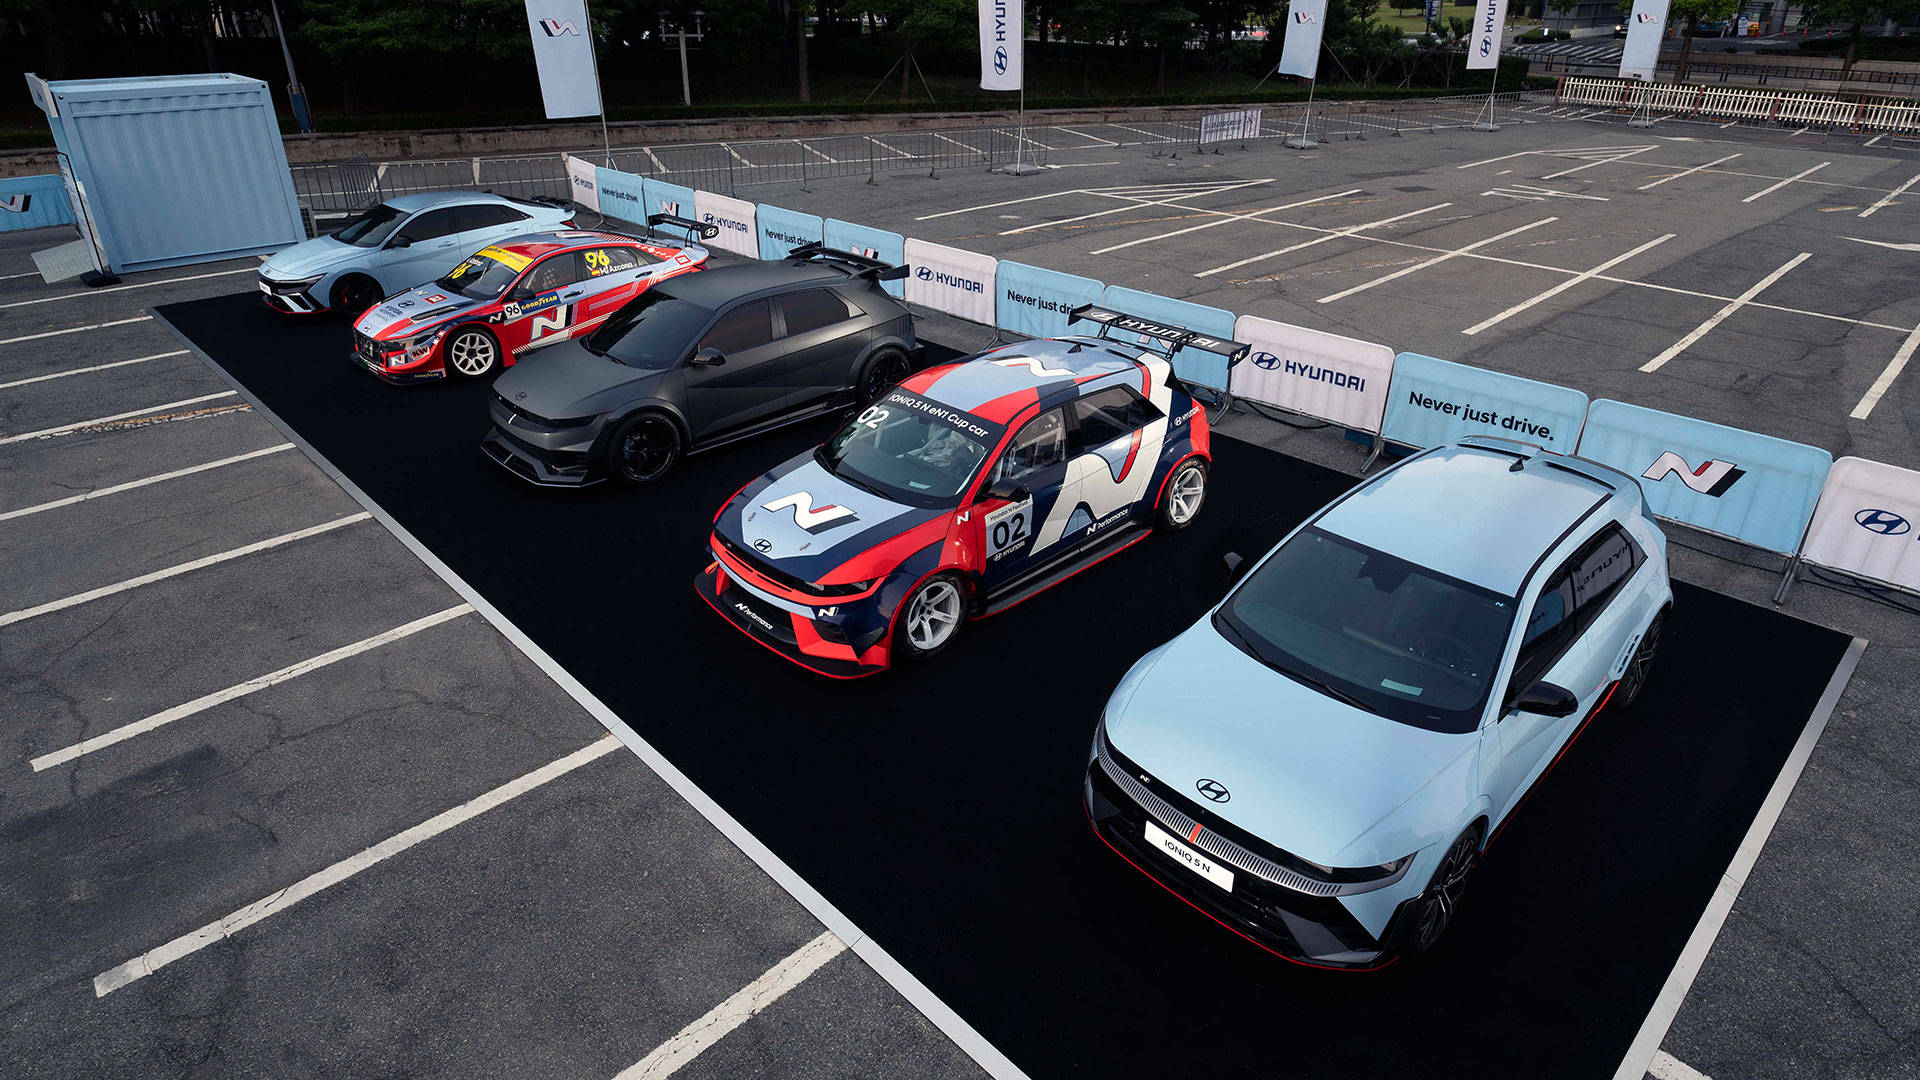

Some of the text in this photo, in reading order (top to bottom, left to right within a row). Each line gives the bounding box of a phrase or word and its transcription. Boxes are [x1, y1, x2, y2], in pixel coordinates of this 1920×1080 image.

[717, 217, 749, 234] HYUNDAI
[784, 232, 797, 243] just
[585, 249, 610, 269] 96
[609, 261, 633, 273] Azcona
[936, 272, 984, 295] HYUNDAI
[505, 304, 520, 316] 96
[521, 294, 558, 311] GOODYEAR
[1007, 289, 1037, 307] Never
[1038, 296, 1058, 312] just
[1119, 318, 1221, 348] HYUNAI
[1285, 359, 1366, 392] HYUNDAI
[857, 406, 890, 430] 02
[888, 394, 916, 408] IONIQ
[919, 404, 932, 413] N
[929, 407, 950, 420] eN1
[947, 414, 970, 428] Cup
[968, 424, 989, 438] car
[1408, 391, 1555, 442] Never just drive.
[957, 511, 970, 526] N
[990, 510, 1008, 521] Hyundai
[1097, 508, 1129, 530] Performance
[992, 512, 1026, 550] 02
[744, 607, 774, 631] Performance
[1164, 839, 1211, 873] IONIQ 5 N
